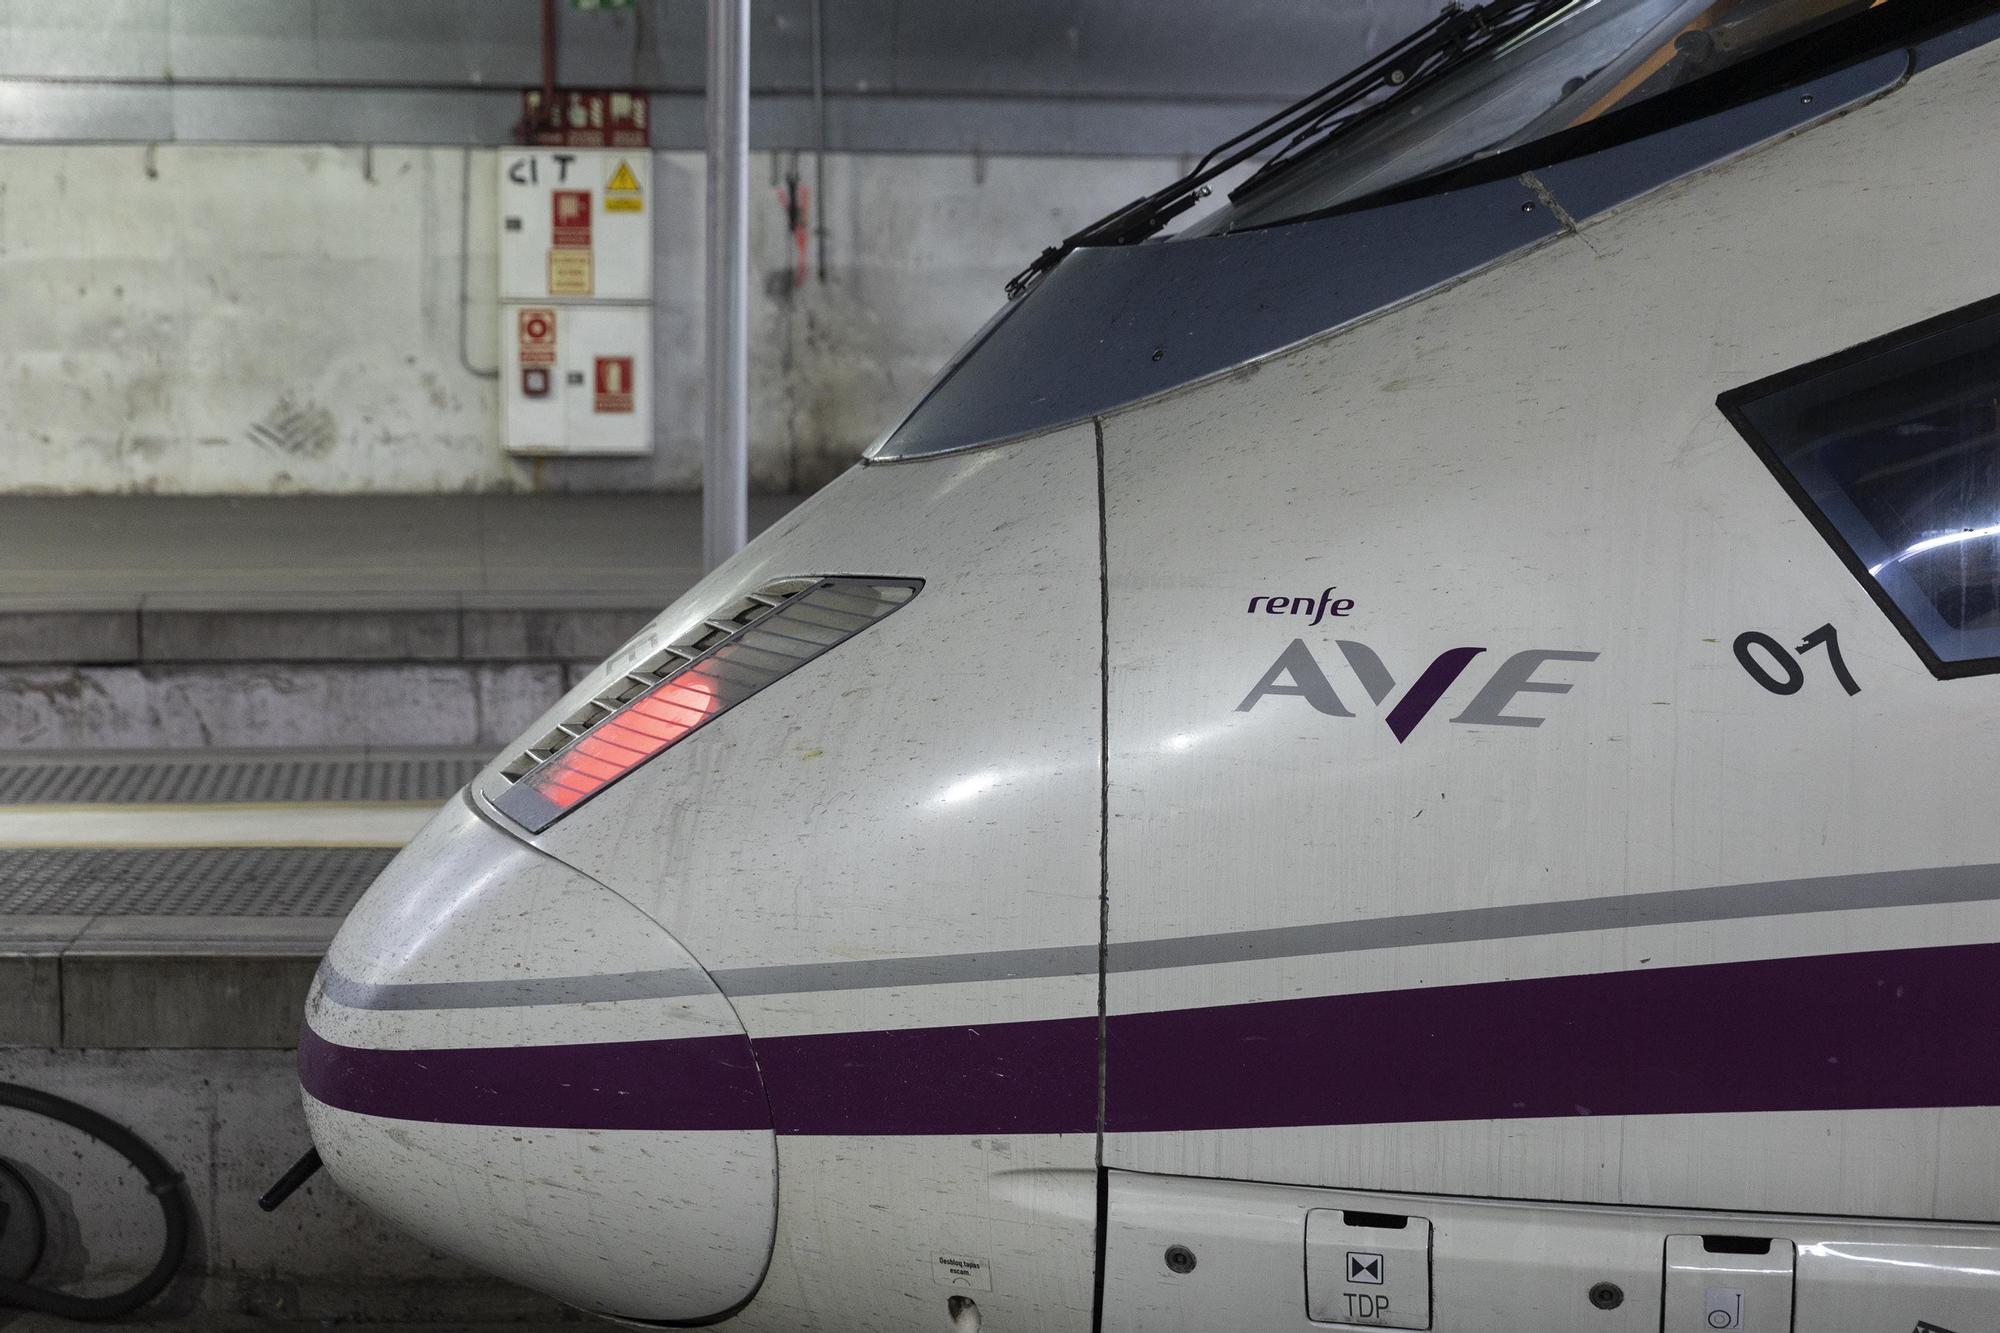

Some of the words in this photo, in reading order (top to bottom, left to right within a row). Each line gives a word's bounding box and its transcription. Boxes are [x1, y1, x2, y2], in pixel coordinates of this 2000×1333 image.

[1247, 586, 1355, 626] renfe
[1732, 622, 1862, 697] 07
[1234, 638, 1601, 744] AVE
[1343, 1292, 1390, 1319] TDP
